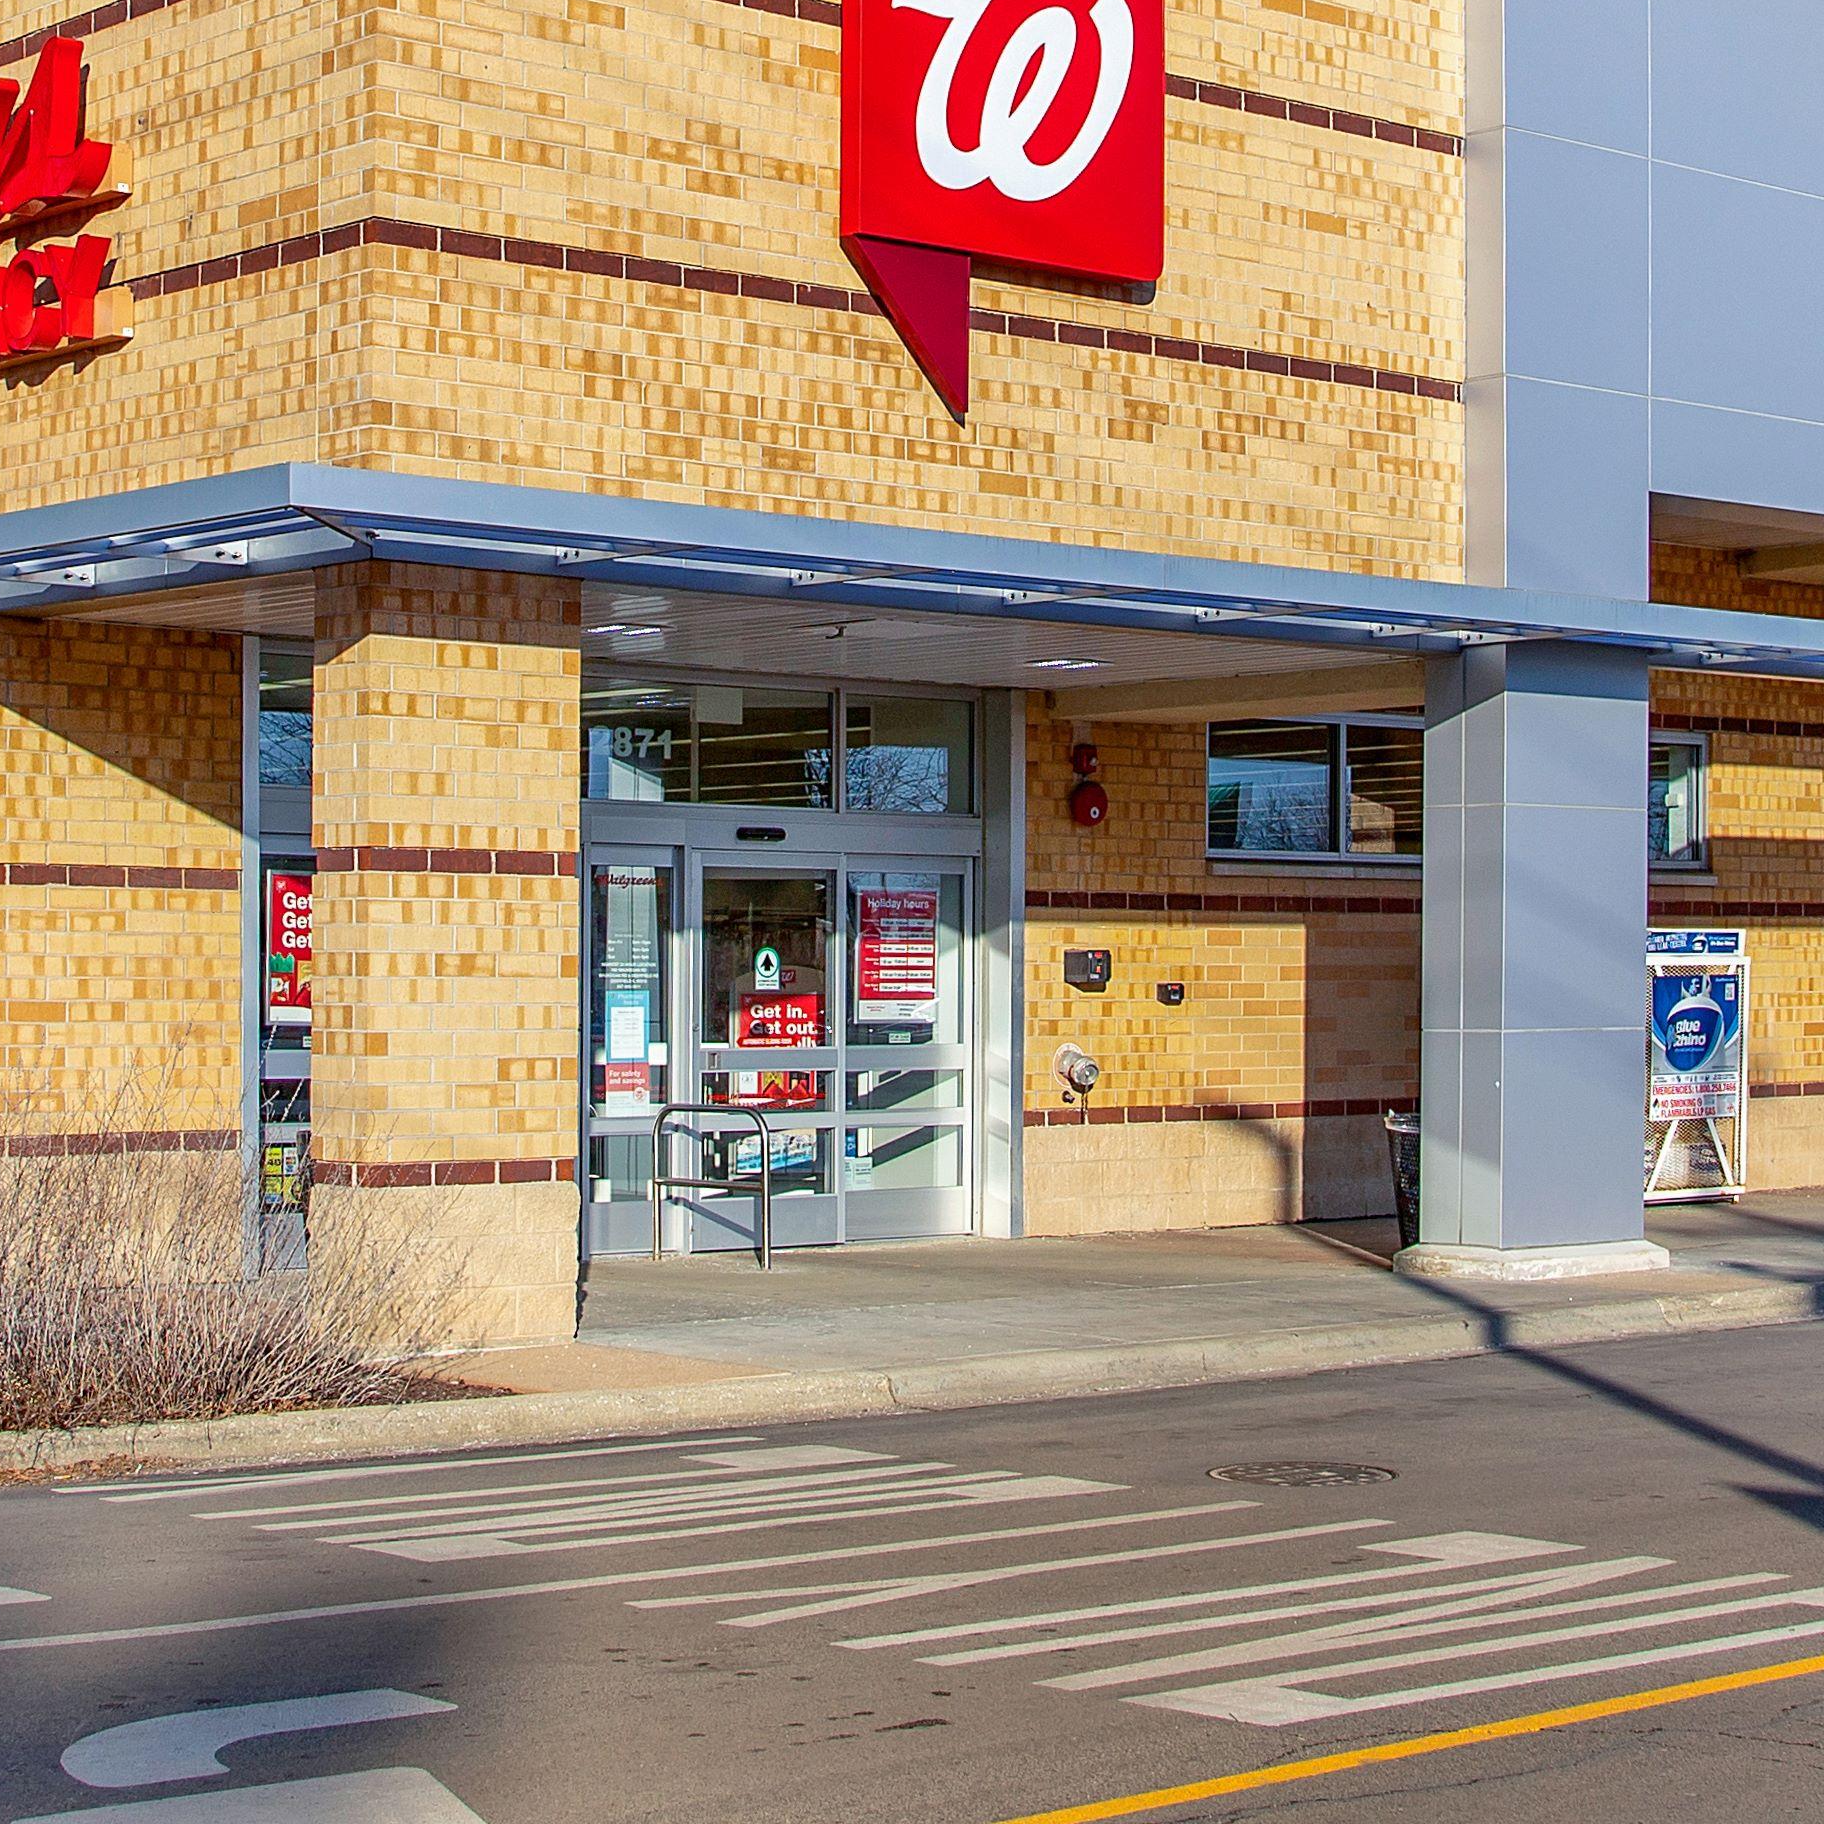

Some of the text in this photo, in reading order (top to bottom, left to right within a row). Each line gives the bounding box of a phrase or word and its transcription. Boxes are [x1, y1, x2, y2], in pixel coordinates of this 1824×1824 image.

[591, 725, 673, 760] 2871
[594, 874, 664, 889] Walgreens
[867, 897, 930, 910] Holiday hours
[750, 1003, 808, 1019] Get in.
[750, 1020, 818, 1035] Get out.
[1676, 1019, 1700, 1034] Blue
[621, 1070, 641, 1078] safety
